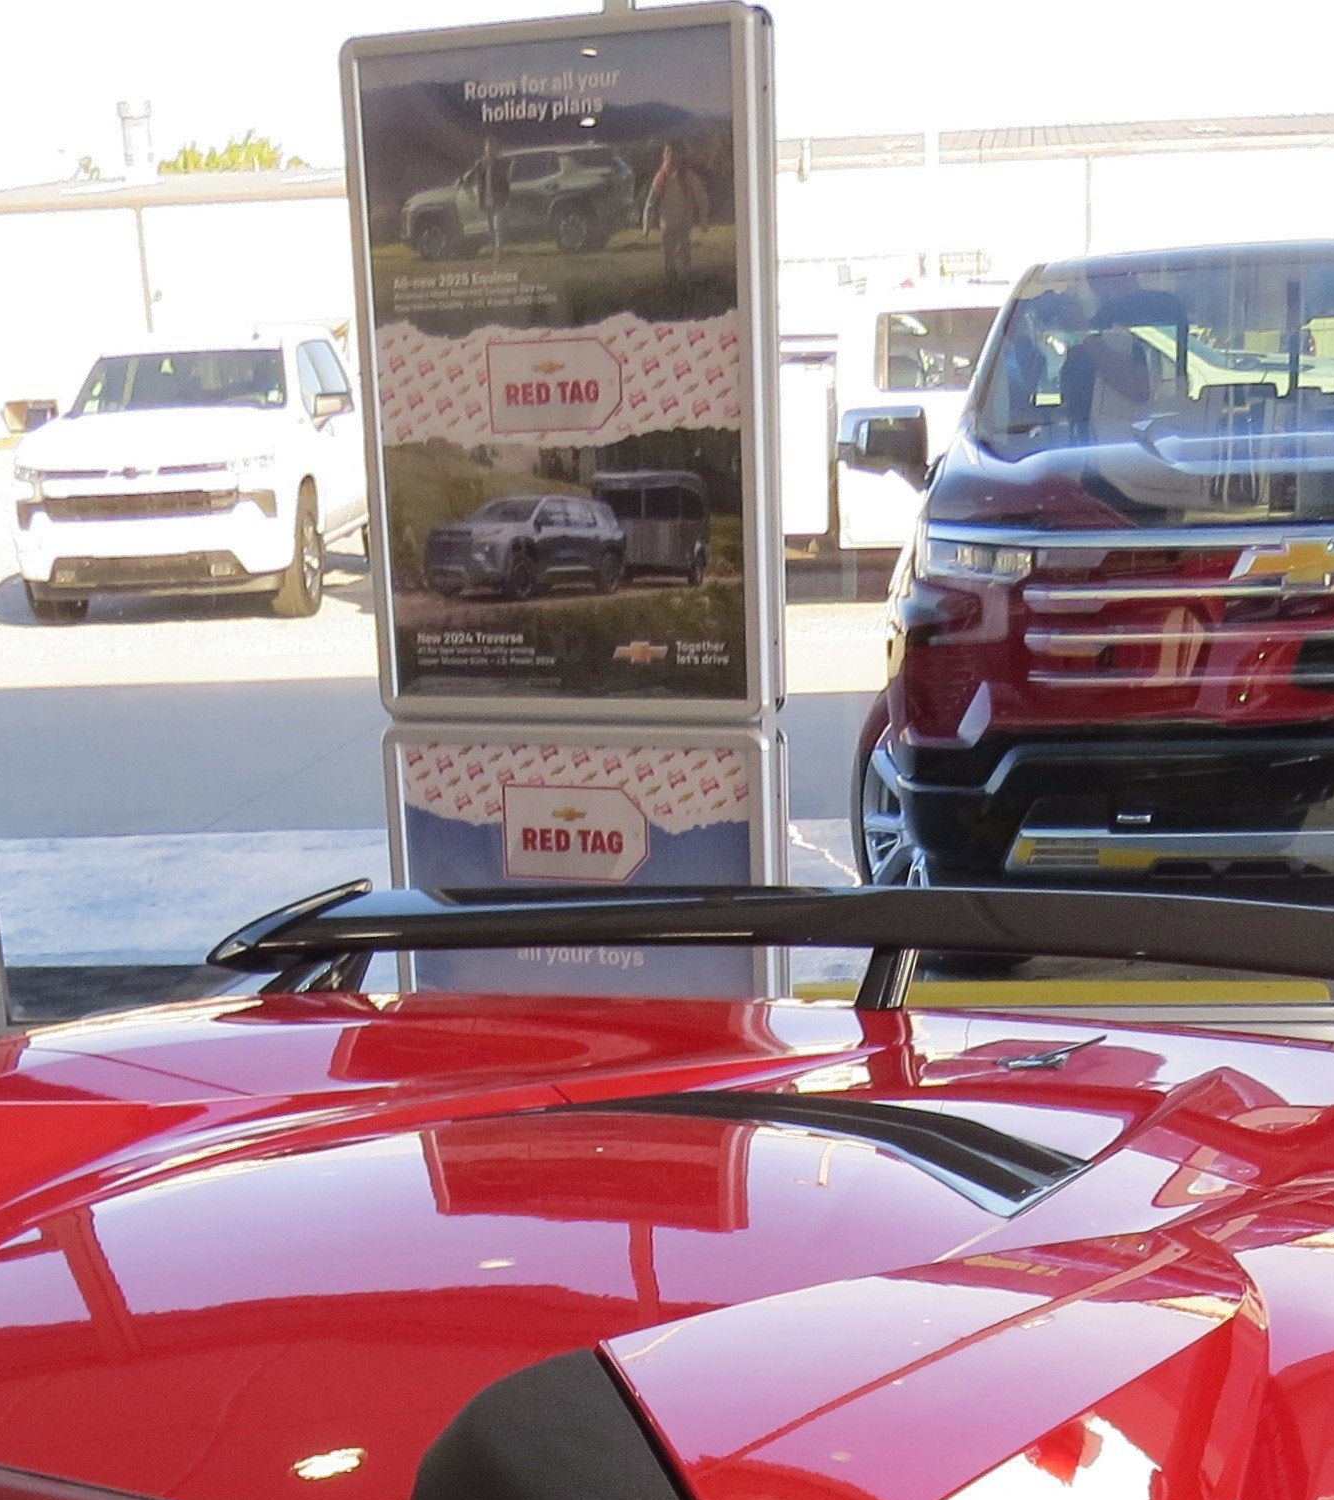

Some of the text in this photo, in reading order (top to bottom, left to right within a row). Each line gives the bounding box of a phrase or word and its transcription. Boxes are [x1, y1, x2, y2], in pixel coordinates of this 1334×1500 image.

[464, 69, 621, 100] Room for all your
[481, 96, 603, 123] holiday plans
[505, 379, 599, 406] RED TAG
[417, 631, 525, 645] New 2024 Traverse
[675, 641, 726, 656] Together
[701, 654, 730, 666] drive
[522, 827, 624, 855] RED TAG
[546, 946, 593, 966] your
[598, 946, 645, 971] toys
